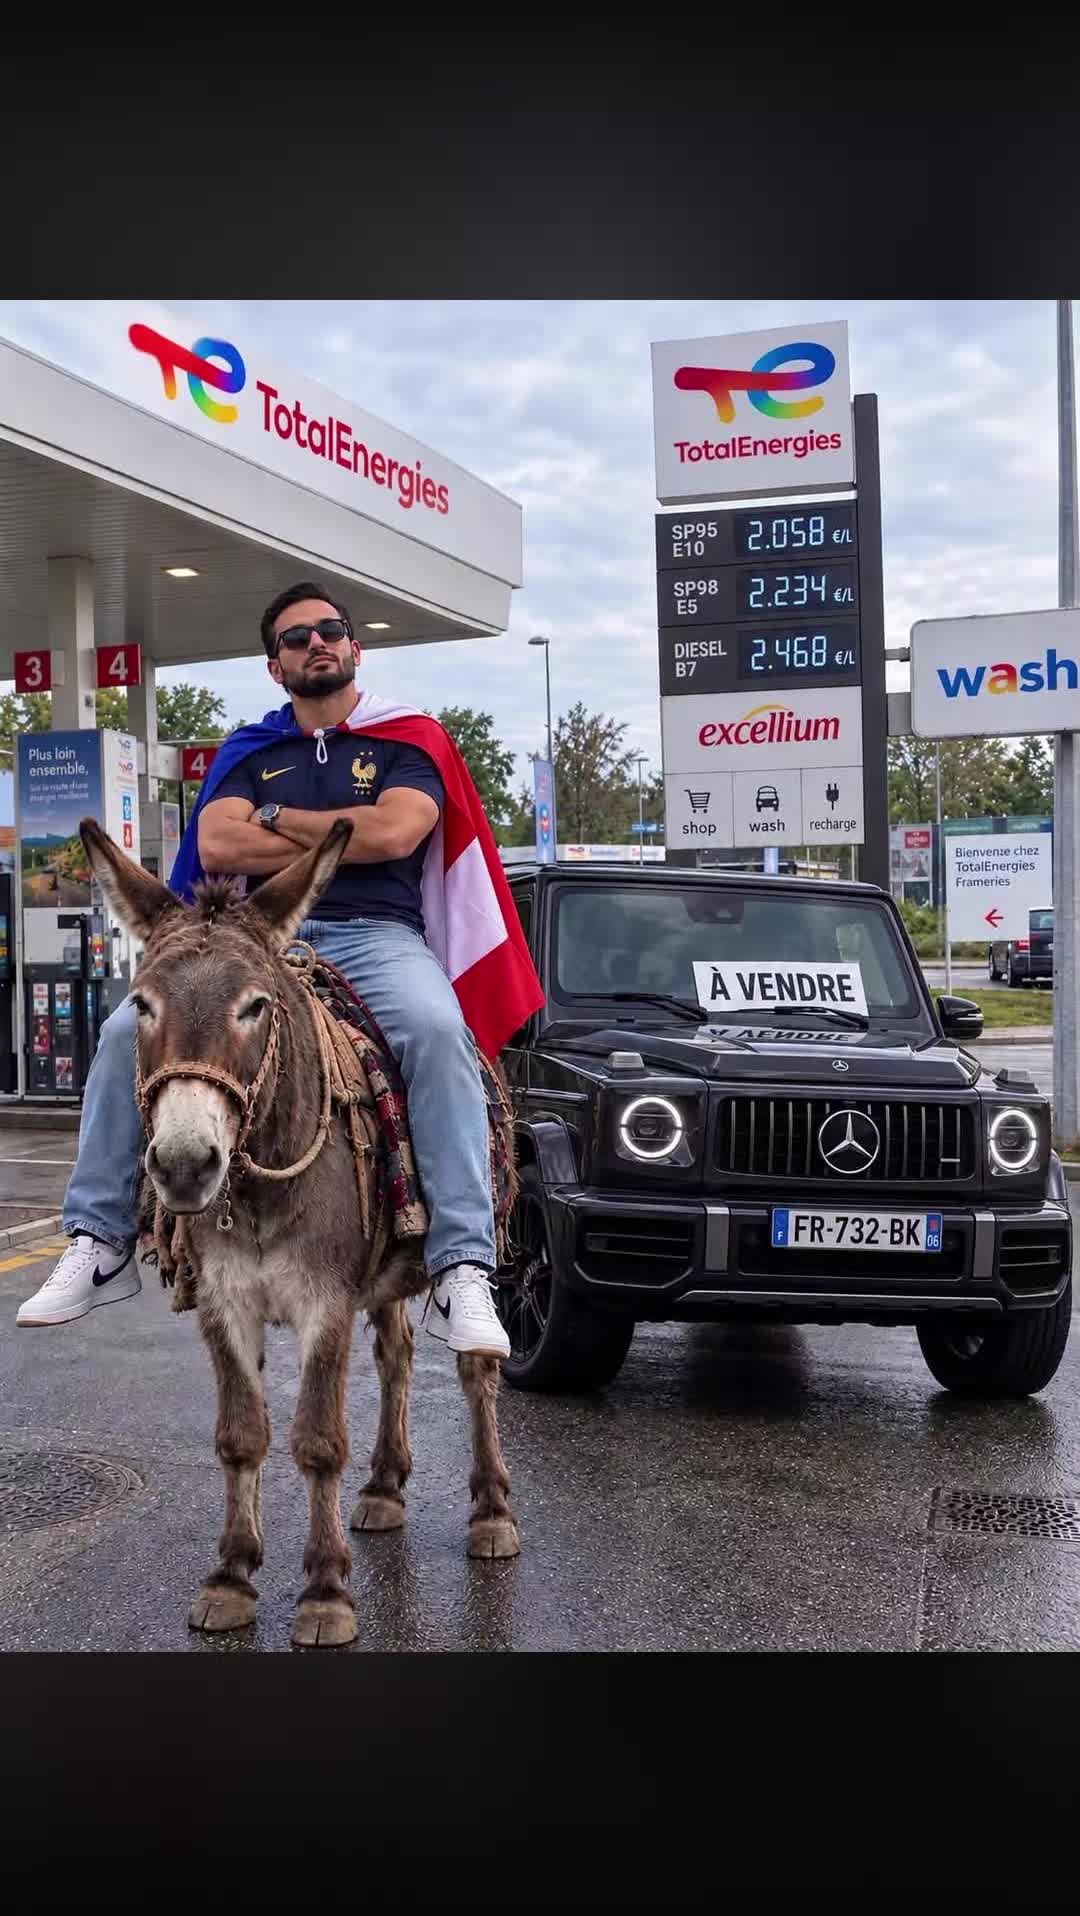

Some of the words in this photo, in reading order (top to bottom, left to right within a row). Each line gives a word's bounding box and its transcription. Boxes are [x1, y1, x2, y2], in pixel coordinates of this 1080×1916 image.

[256, 380, 449, 514] TotalEnergies
[674, 429, 842, 463] TotalEnergies
[671, 522, 718, 540] SP95
[748, 516, 825, 550] 2.058
[832, 529, 853, 544] €/L
[672, 541, 705, 557] E10
[673, 580, 719, 597] SP98
[749, 575, 827, 608] 2.234
[833, 588, 854, 603] €/L
[677, 599, 697, 615] E5
[674, 640, 727, 659] DIESEL
[751, 636, 827, 671] 2.468
[834, 651, 855, 665] €/L
[25, 656, 43, 687] 3
[108, 651, 129, 681] 4
[675, 662, 697, 678] B7
[936, 649, 1078, 698] wash
[698, 711, 840, 747] excellium
[28, 747, 52, 761] Plus
[55, 747, 76, 760] loin
[29, 762, 89, 777] ensemble,
[191, 752, 207, 775] 4
[682, 821, 717, 836] shop
[749, 819, 785, 832] wash
[809, 818, 857, 832] recharge
[1013, 845, 1040, 857] chez
[956, 860, 1036, 874] TotalEnergies
[956, 876, 1011, 888] Frameries
[710, 966, 731, 1001] À
[736, 972, 856, 1002] VENDRE
[777, 1231, 784, 1240] F
[794, 1215, 921, 1246] FR-732-BK
[927, 1234, 939, 1247] 06
